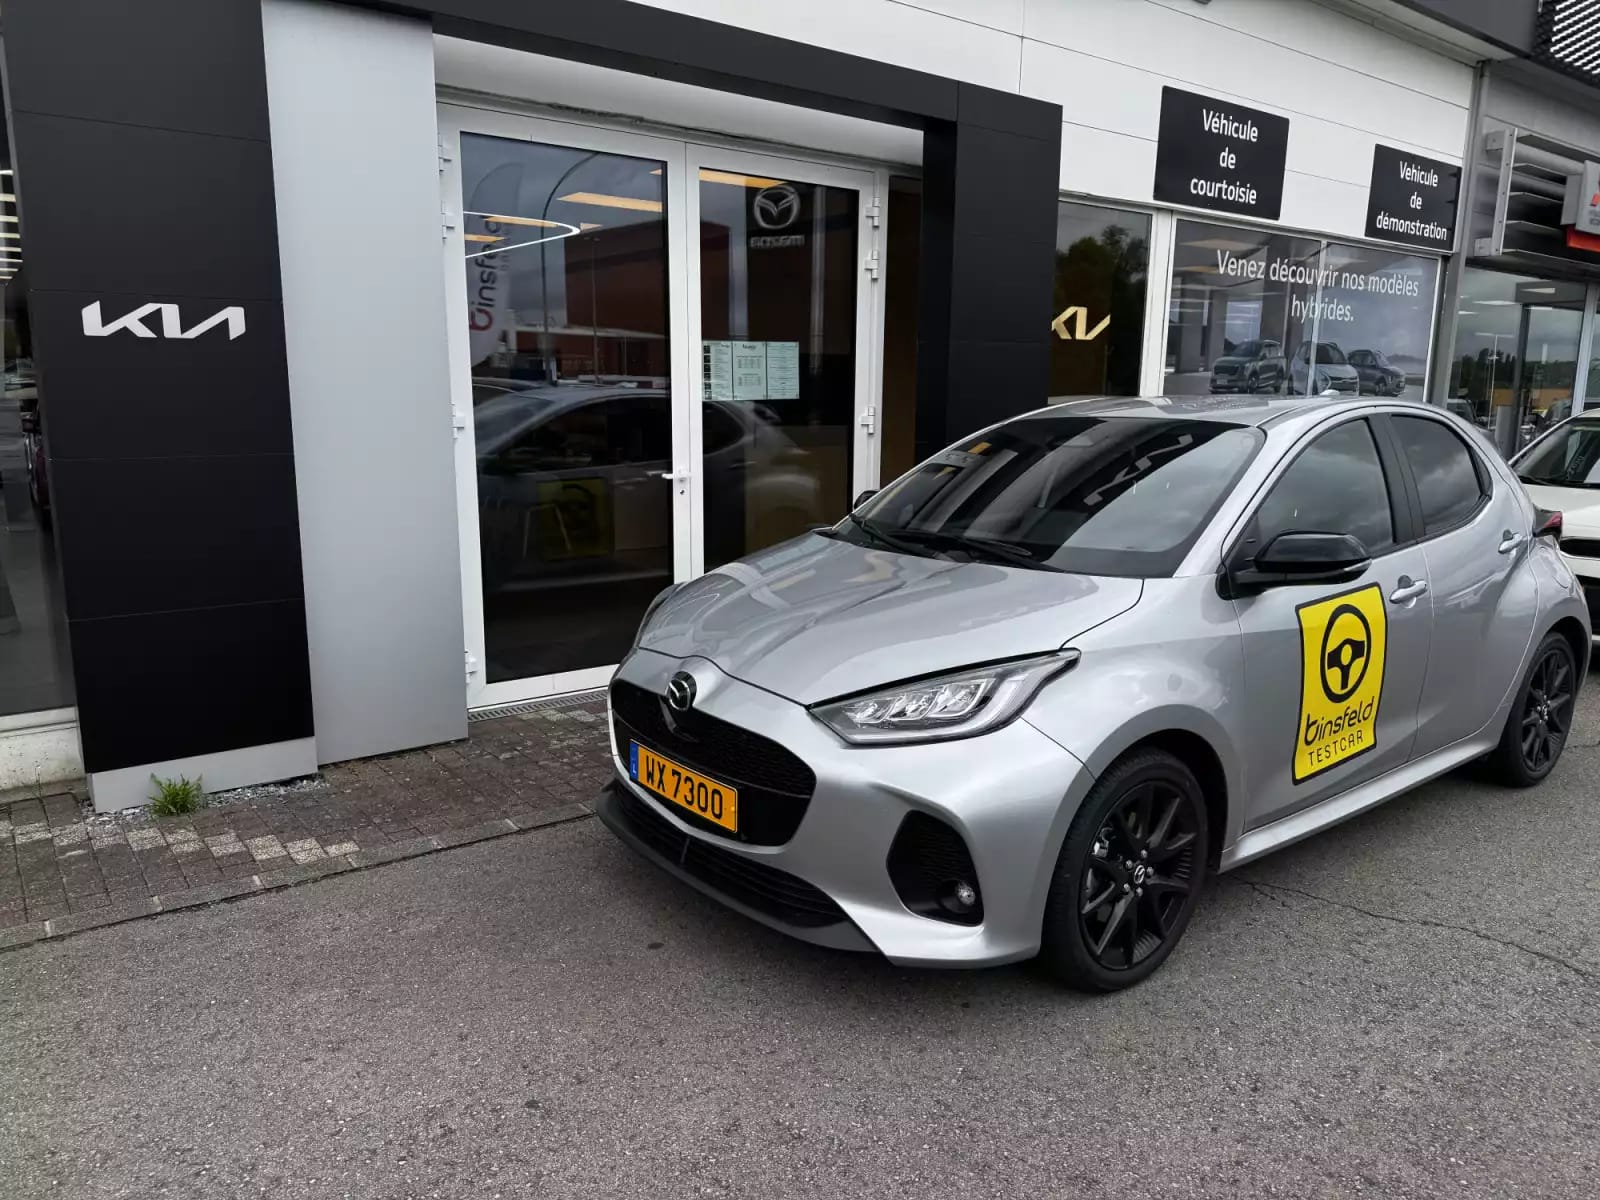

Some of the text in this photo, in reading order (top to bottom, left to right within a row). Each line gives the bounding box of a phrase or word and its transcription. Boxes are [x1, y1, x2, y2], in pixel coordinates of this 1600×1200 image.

[1202, 108, 1259, 142] Véhicule
[1219, 146, 1237, 169] de
[1399, 160, 1439, 187] Vehicule
[1190, 177, 1258, 205] courtoisie
[1409, 191, 1423, 210] de
[1375, 210, 1448, 241] démonstration
[1216, 249, 1419, 297] Venez découvrir nos modèles
[81, 299, 247, 341] KIA
[1291, 294, 1354, 324] hybrides.
[1304, 696, 1375, 746] binsfeld
[1308, 729, 1364, 767] TESTCAR
[645, 754, 666, 793] WX
[671, 768, 723, 821] 7300
